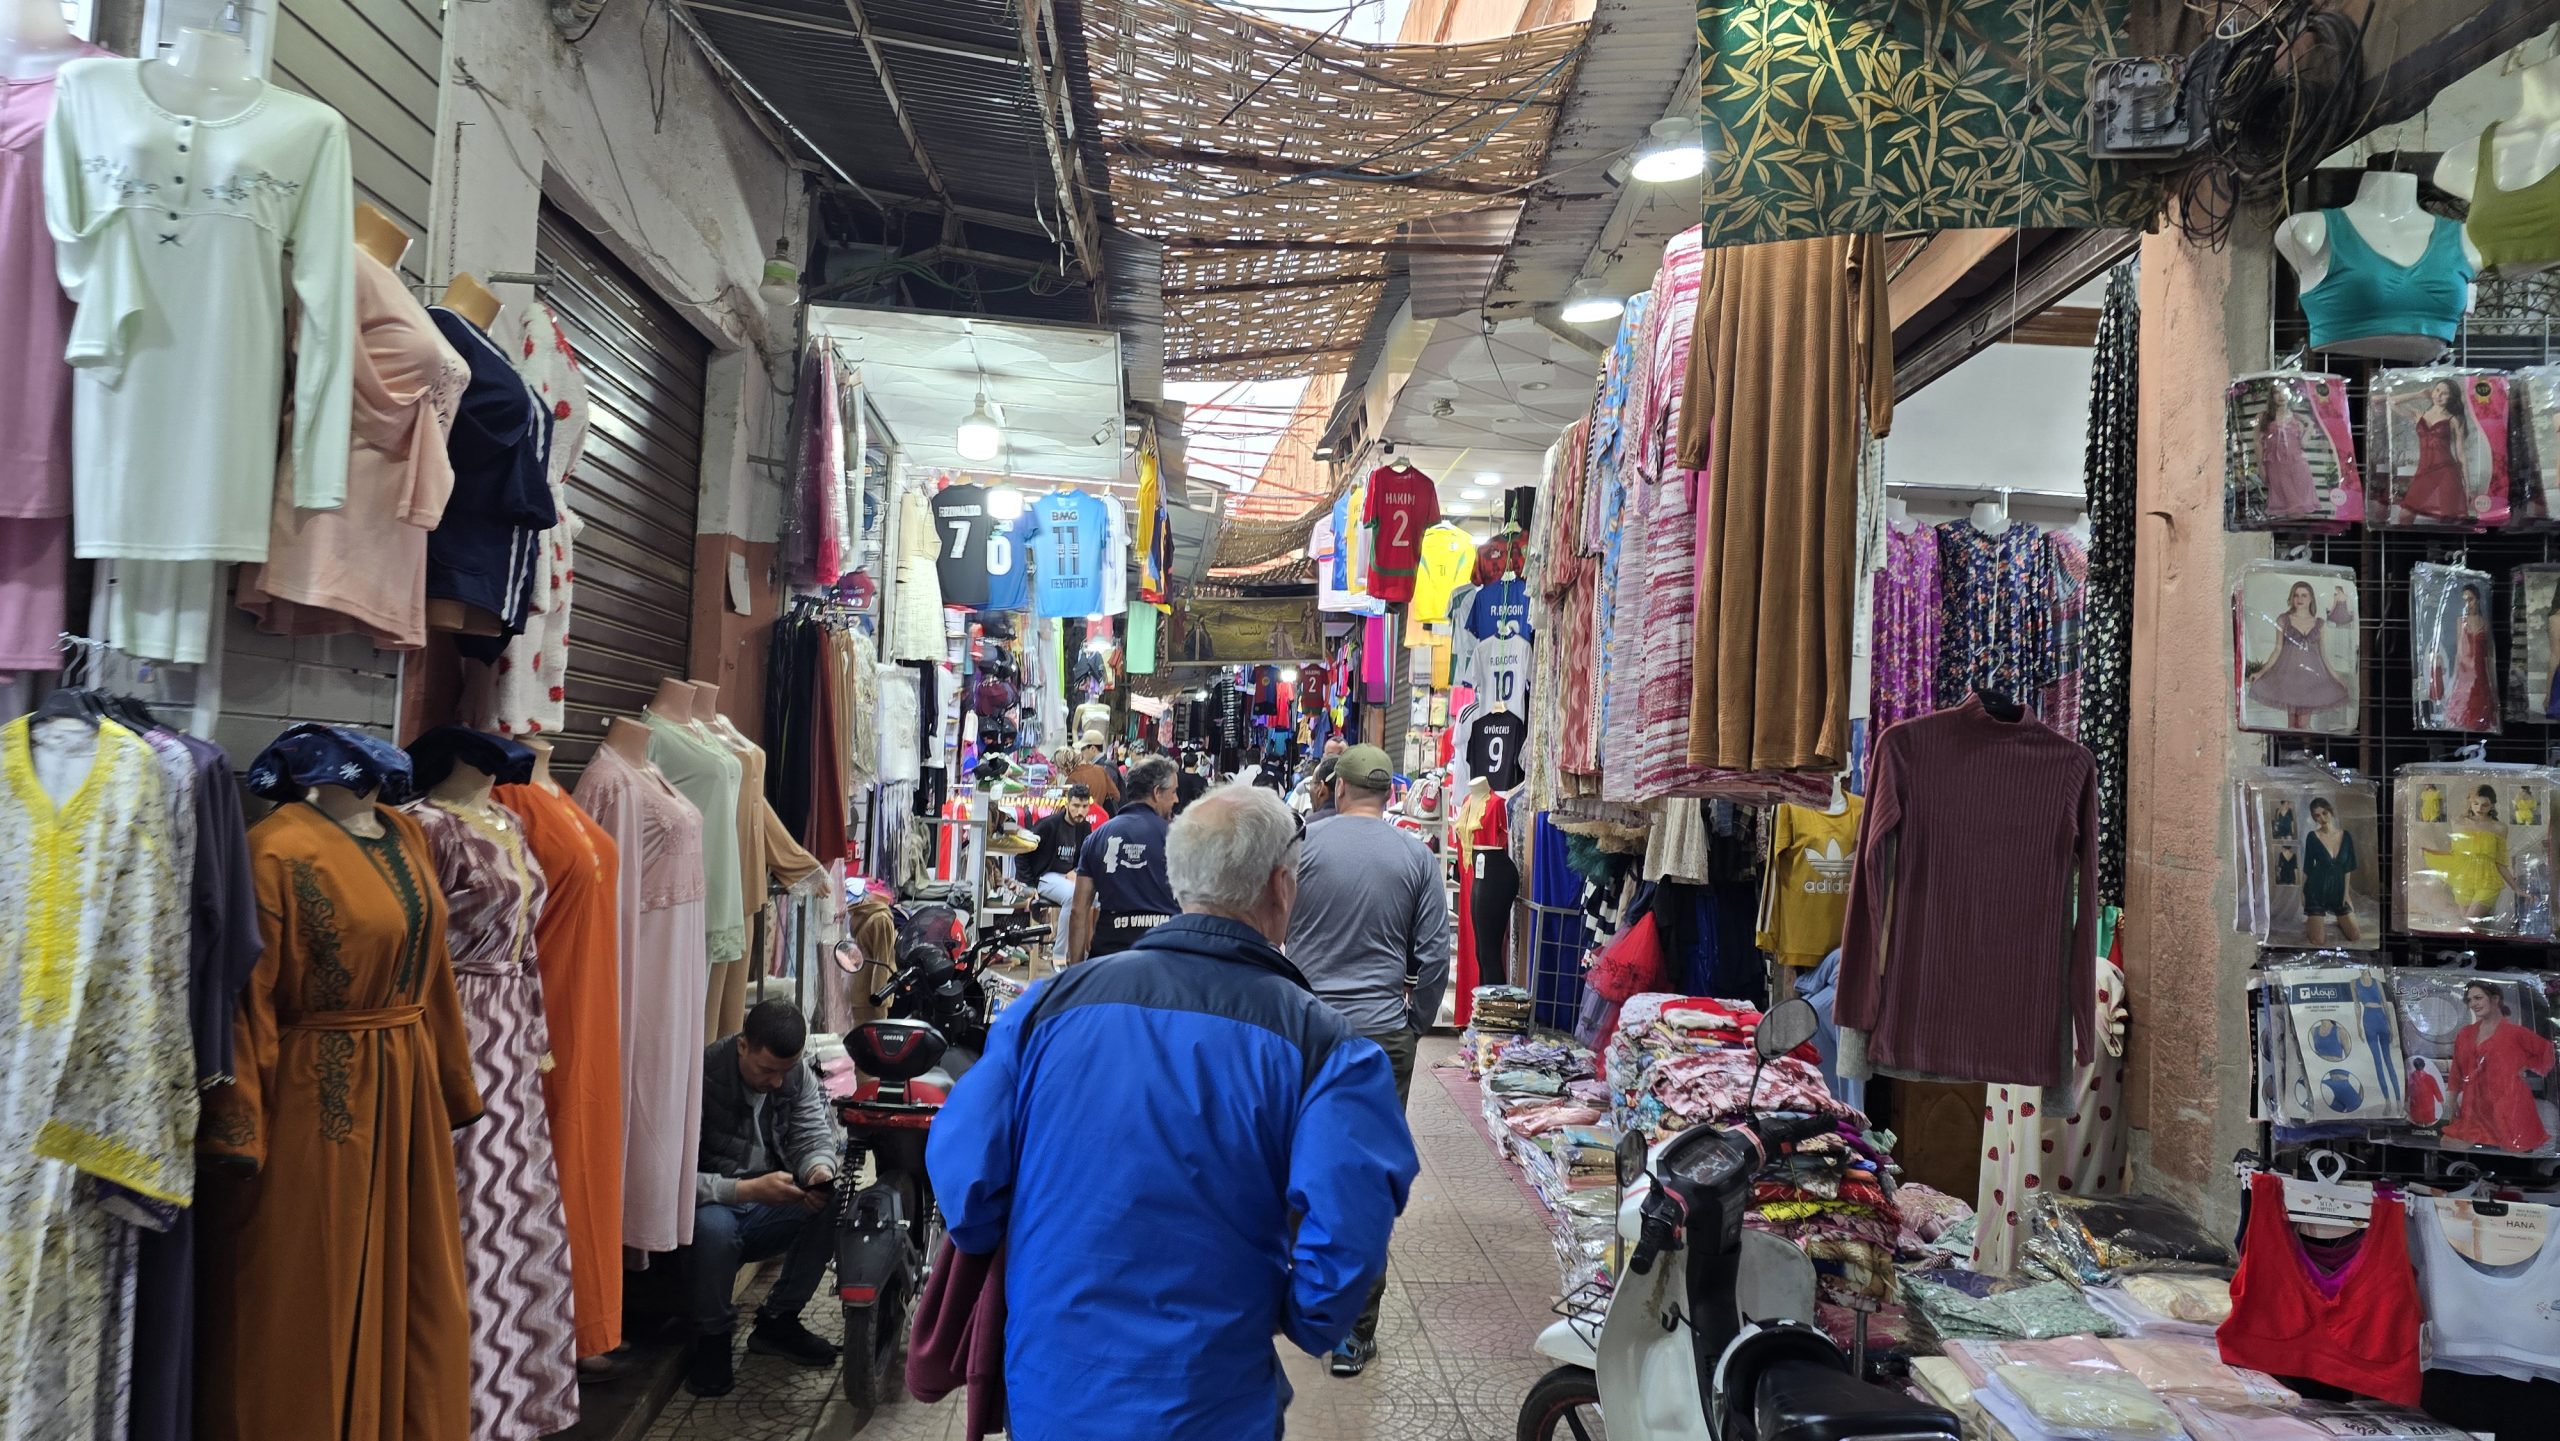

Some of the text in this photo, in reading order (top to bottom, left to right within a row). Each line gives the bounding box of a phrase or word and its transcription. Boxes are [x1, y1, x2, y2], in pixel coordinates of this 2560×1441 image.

[948, 521, 971, 559] 7
[1392, 510, 1409, 547] 2
[1052, 527, 1080, 575] 11
[1309, 676, 1316, 693] 2
[1494, 670, 1514, 702] 10
[1488, 736, 1504, 773] 9
[1804, 879, 1852, 894] adida
[1114, 914, 1170, 929] WANNA GO
[2506, 1220, 2536, 1230] HANA
